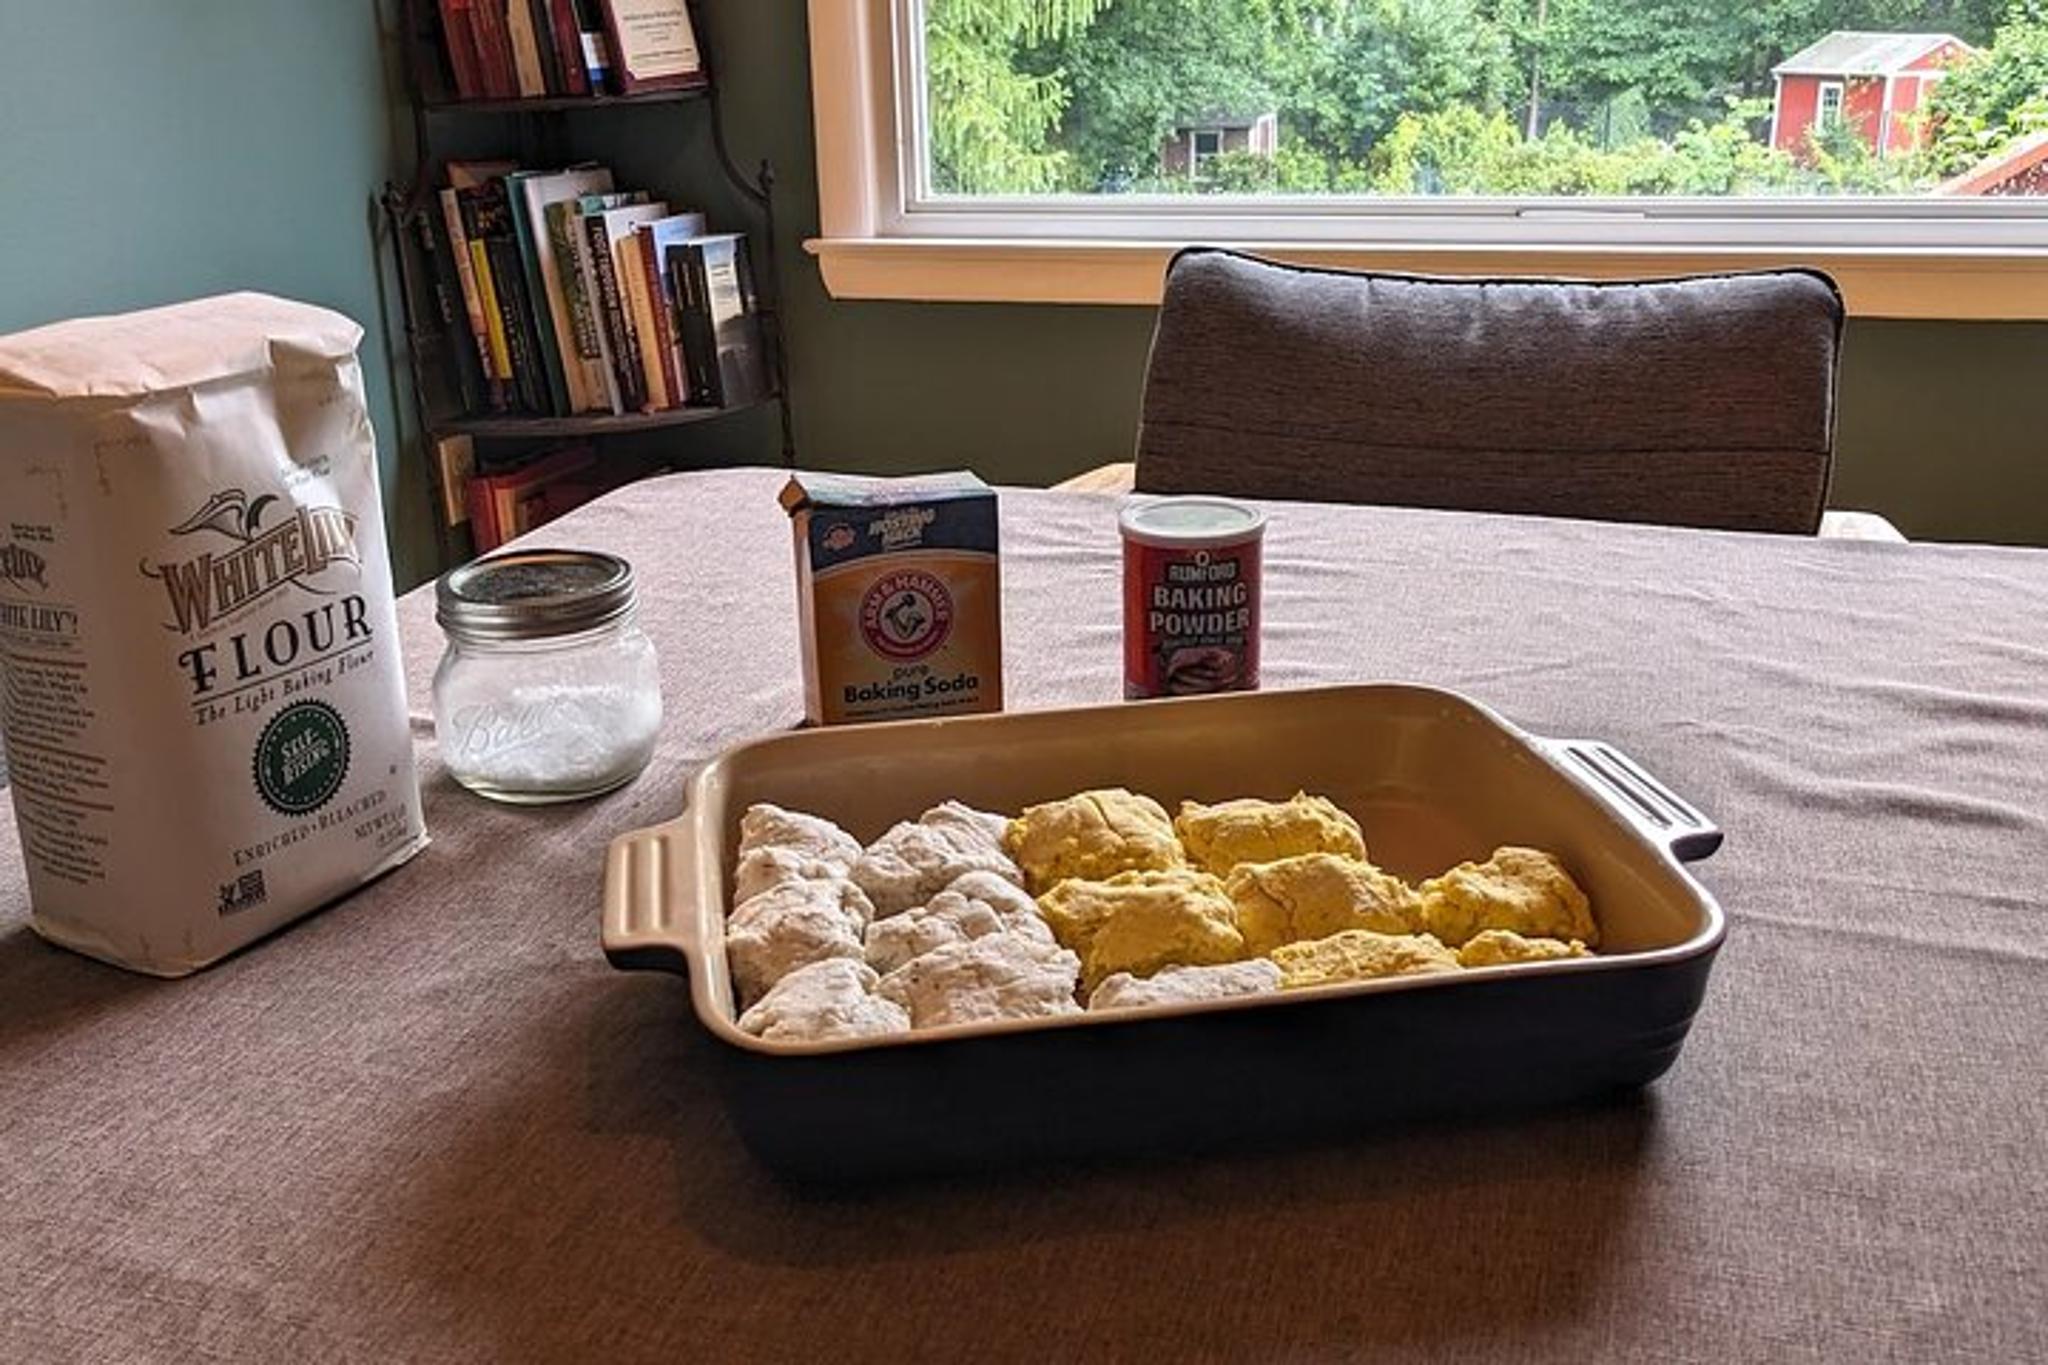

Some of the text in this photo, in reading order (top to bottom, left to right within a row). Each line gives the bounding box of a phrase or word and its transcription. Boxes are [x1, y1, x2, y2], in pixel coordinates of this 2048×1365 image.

[1168, 562, 1236, 582] RUMFORD
[1153, 582, 1248, 610] BAKING
[1149, 608, 1250, 635] POWDER
[178, 594, 374, 695] FLOUR
[892, 664, 929, 681] pure
[194, 650, 375, 726] The Light Baking Flour
[844, 672, 979, 703] Baking Soda
